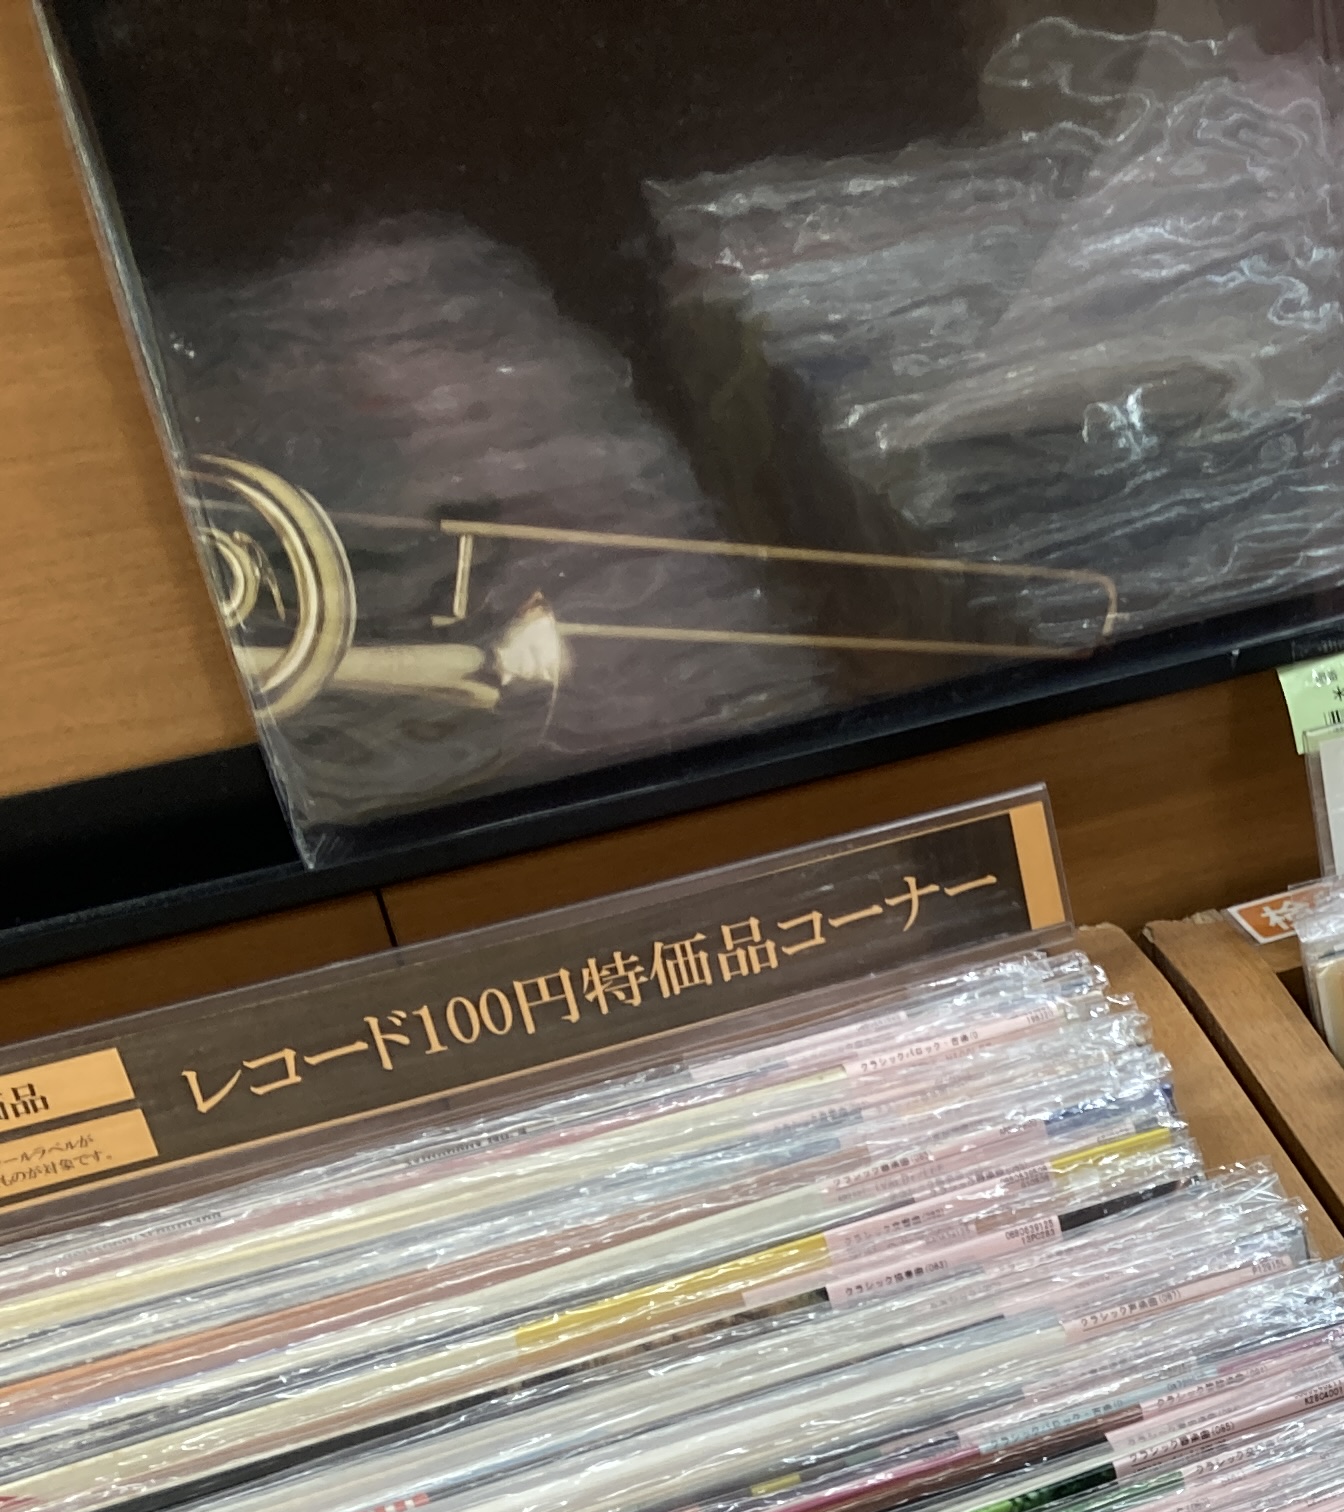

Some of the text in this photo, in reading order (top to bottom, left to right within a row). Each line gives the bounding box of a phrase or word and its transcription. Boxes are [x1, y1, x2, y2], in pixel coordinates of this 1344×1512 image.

[181, 868, 998, 1116] レコード100円特価品コーナー
